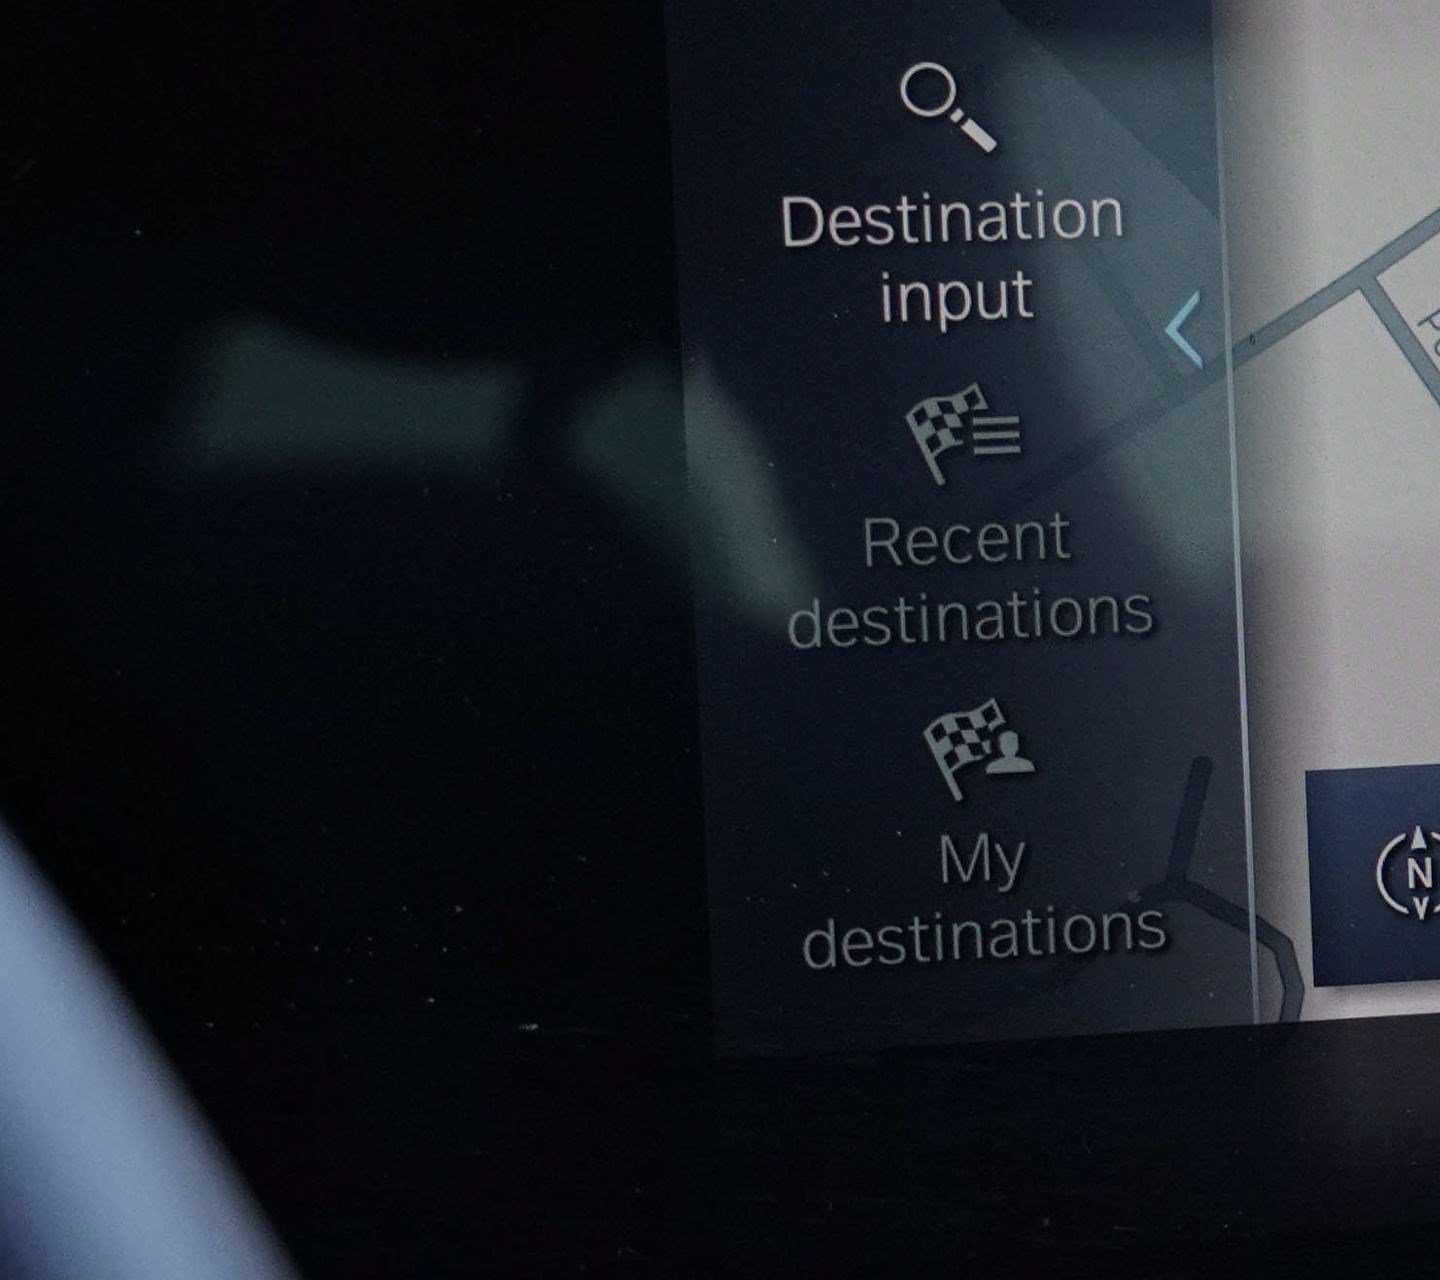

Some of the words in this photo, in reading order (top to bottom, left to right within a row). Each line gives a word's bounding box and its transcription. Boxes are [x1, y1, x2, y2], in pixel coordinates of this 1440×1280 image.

[782, 188, 1124, 249] Destination
[882, 270, 1035, 333] input
[864, 511, 1071, 567] Recent
[788, 588, 1155, 650] destinations
[939, 833, 1027, 894] My
[1407, 857, 1433, 889] N
[802, 905, 1168, 970] destinations
